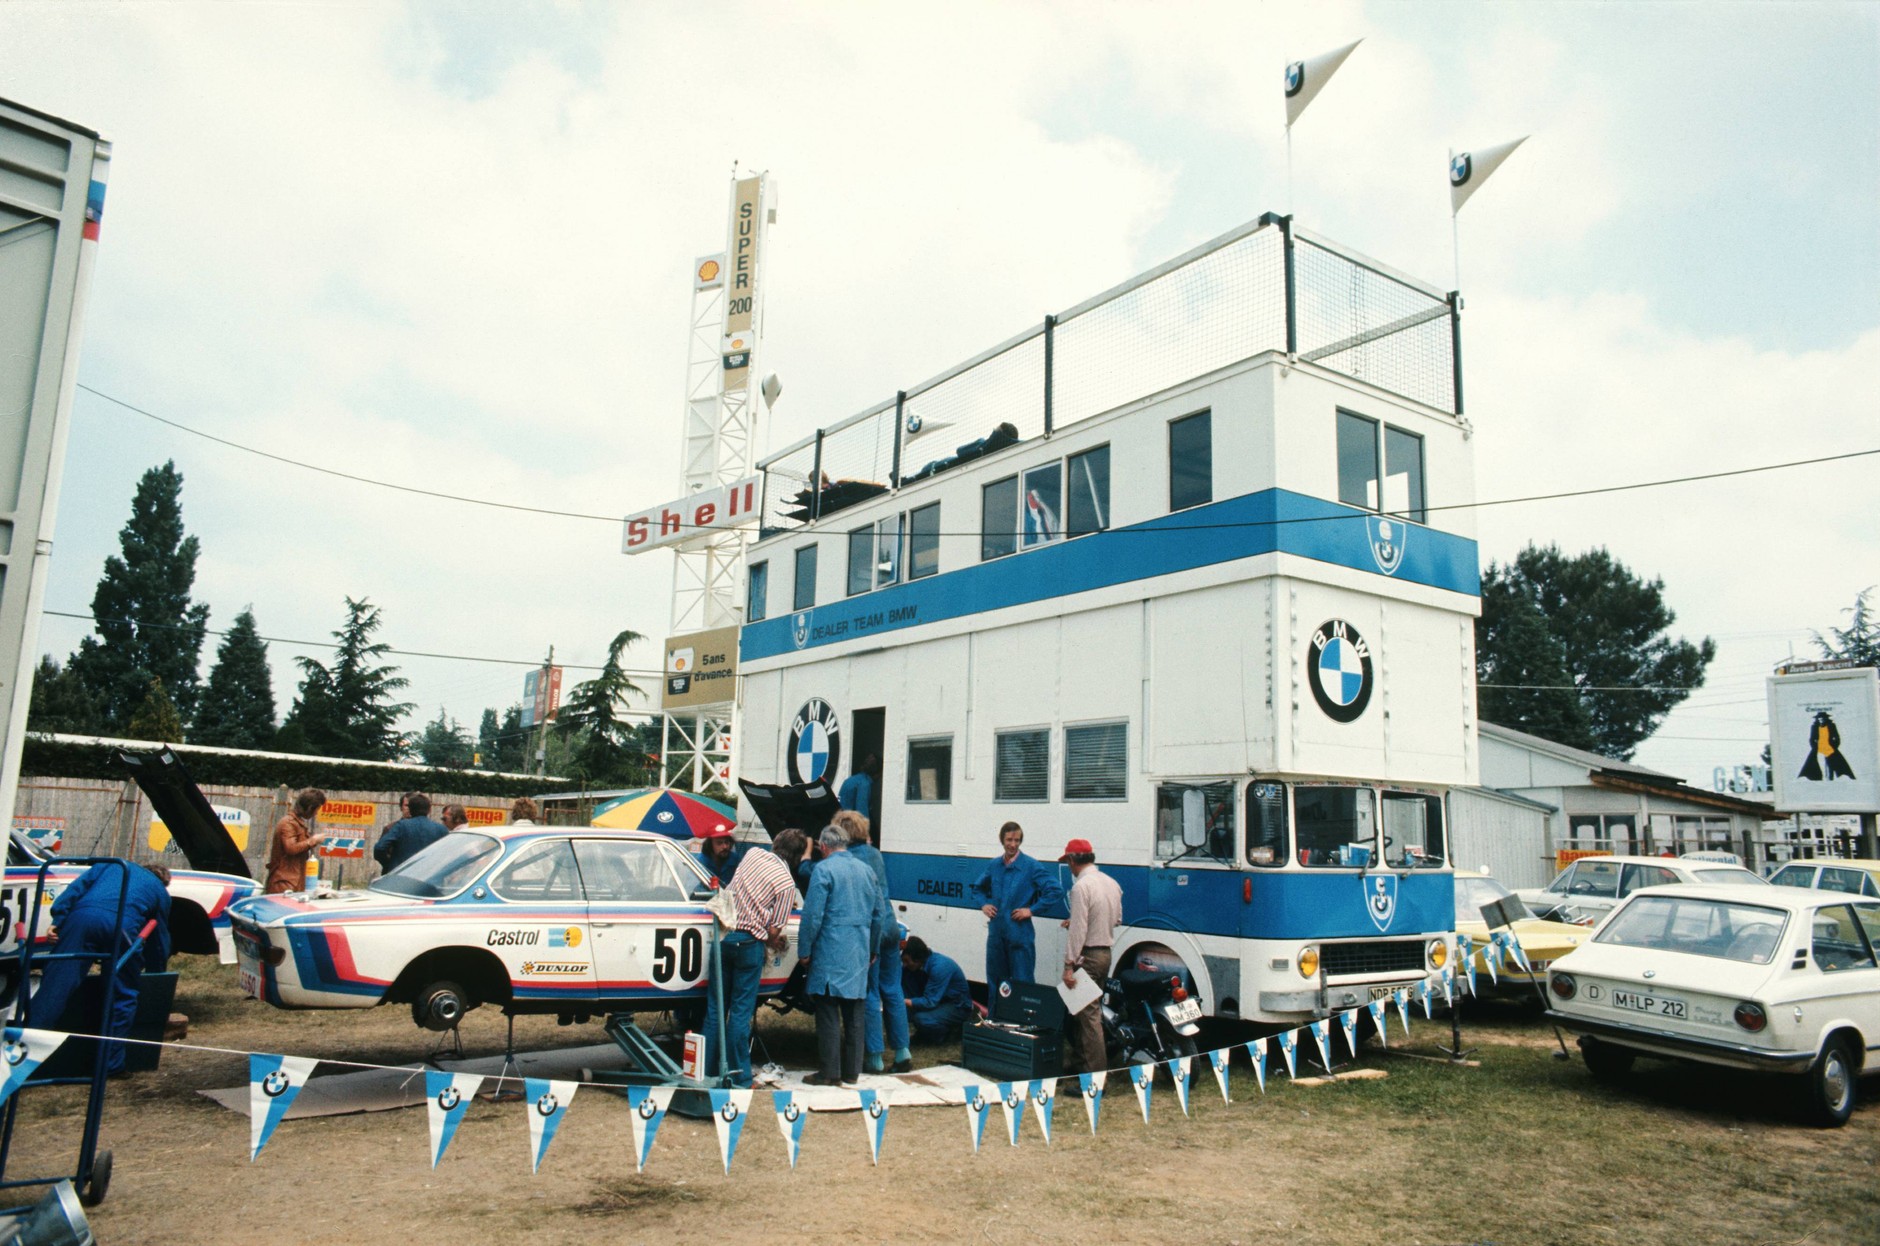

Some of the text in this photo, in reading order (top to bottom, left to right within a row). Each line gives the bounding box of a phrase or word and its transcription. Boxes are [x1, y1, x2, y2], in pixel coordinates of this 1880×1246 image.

[736, 203, 753, 289] SUPER
[729, 296, 752, 316] 200
[627, 483, 753, 546] Shell
[812, 605, 918, 640] DEALER TEAM BMW
[1313, 620, 1370, 658] BMW
[793, 700, 838, 739] BMW
[917, 879, 963, 898] DEALER
[487, 929, 540, 947] Castrol
[535, 965, 588, 973] DUNLOP
[653, 927, 703, 984] 50
[1589, 986, 1599, 999] D
[1662, 1001, 1684, 1016] 212
